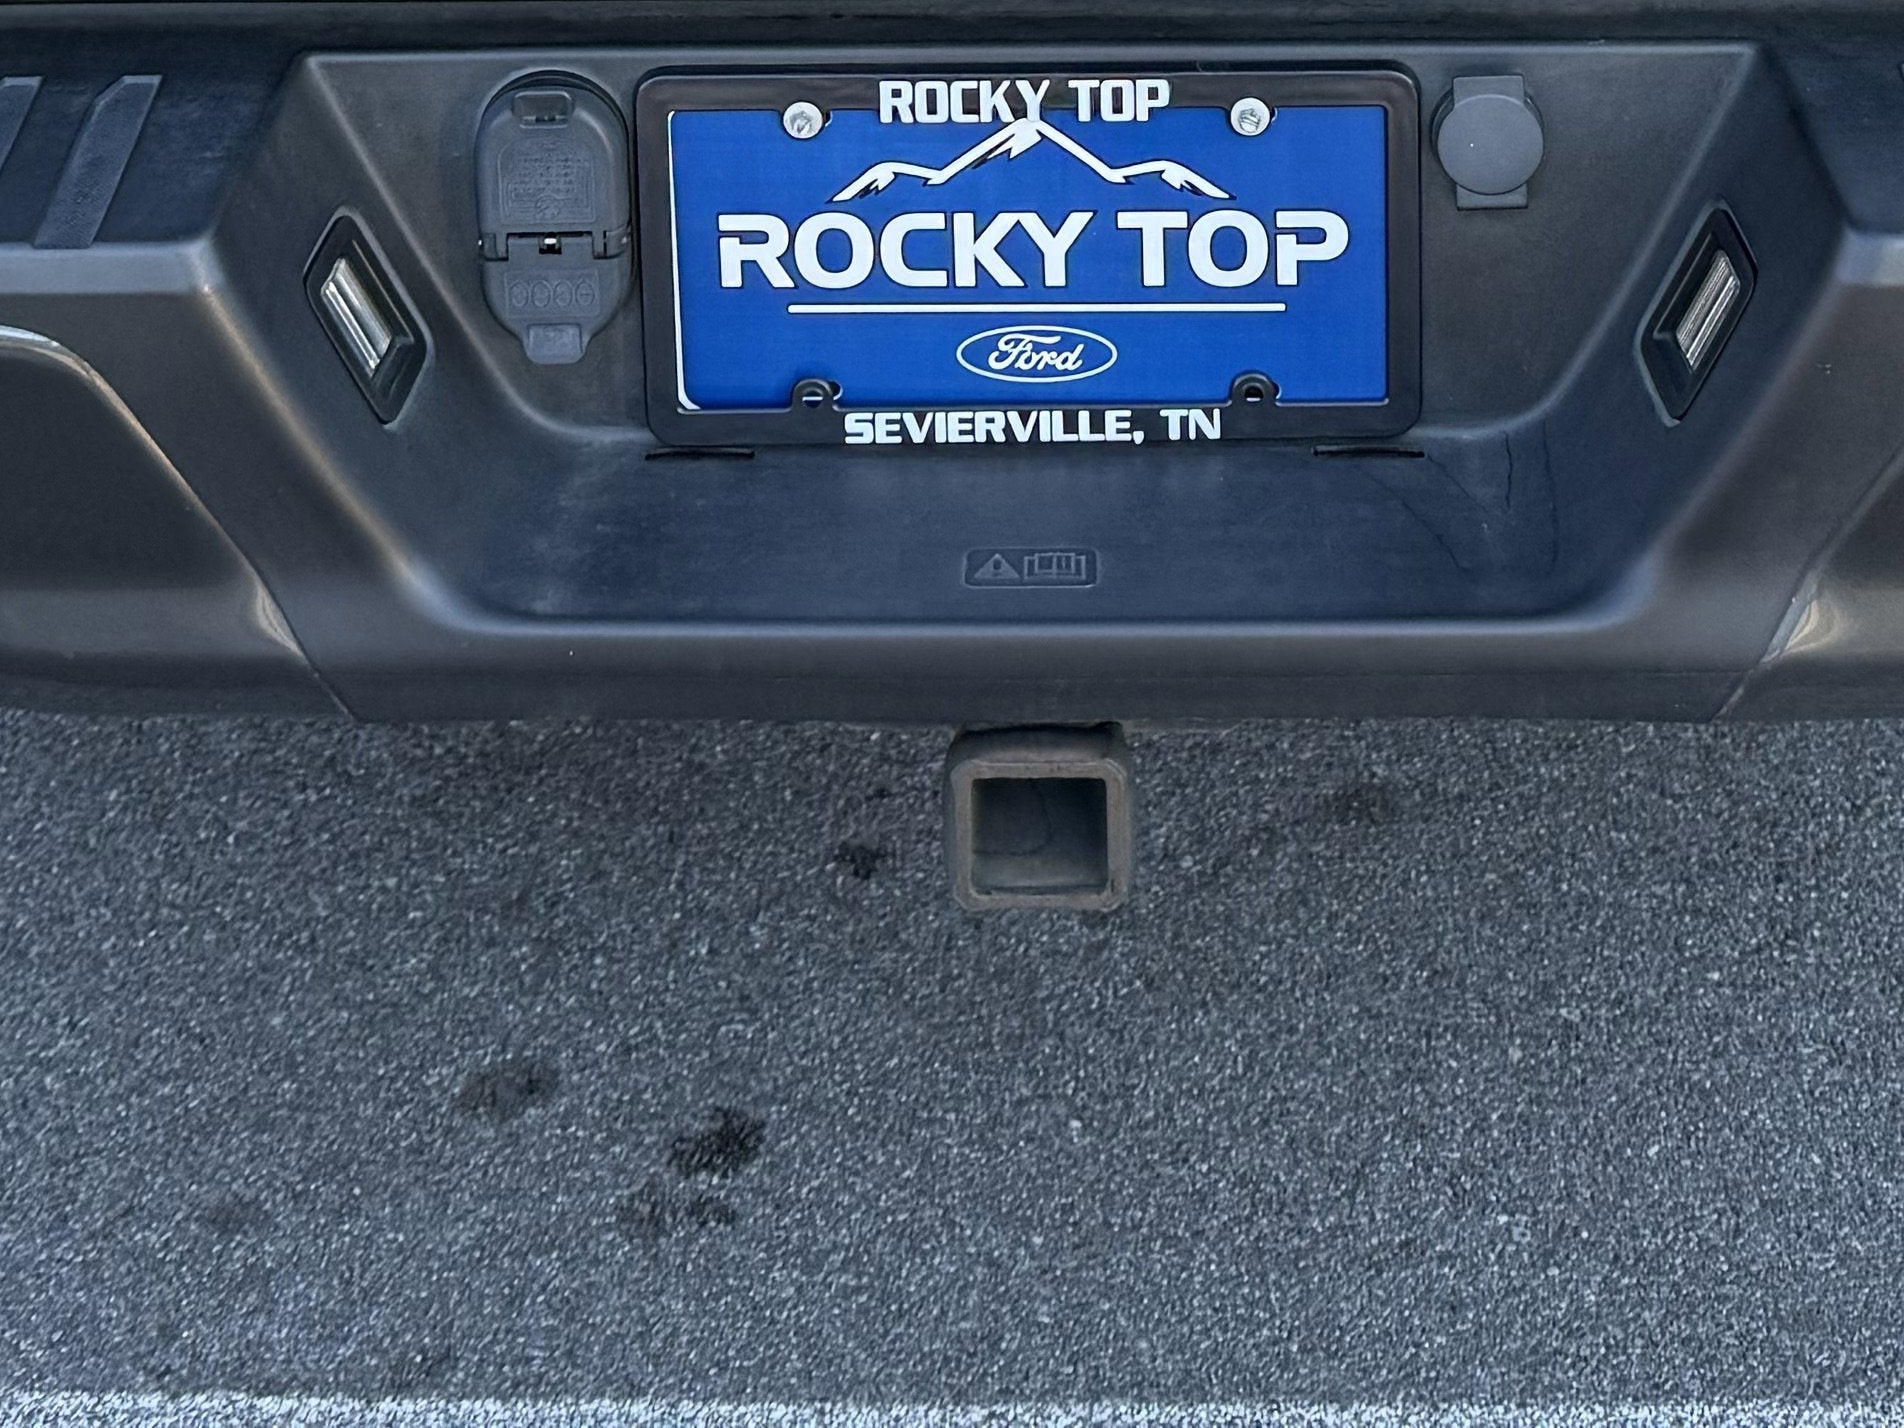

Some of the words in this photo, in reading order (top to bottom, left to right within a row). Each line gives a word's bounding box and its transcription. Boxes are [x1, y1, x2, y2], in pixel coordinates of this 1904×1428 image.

[878, 79, 1050, 124] ROCKY
[1068, 79, 1170, 123] TOP
[717, 210, 1095, 288] ROCKY
[1116, 209, 1350, 287] TOP
[988, 333, 1084, 371] Ford
[844, 409, 1145, 445] SEVIERVILLE,
[1160, 409, 1221, 440] TN
